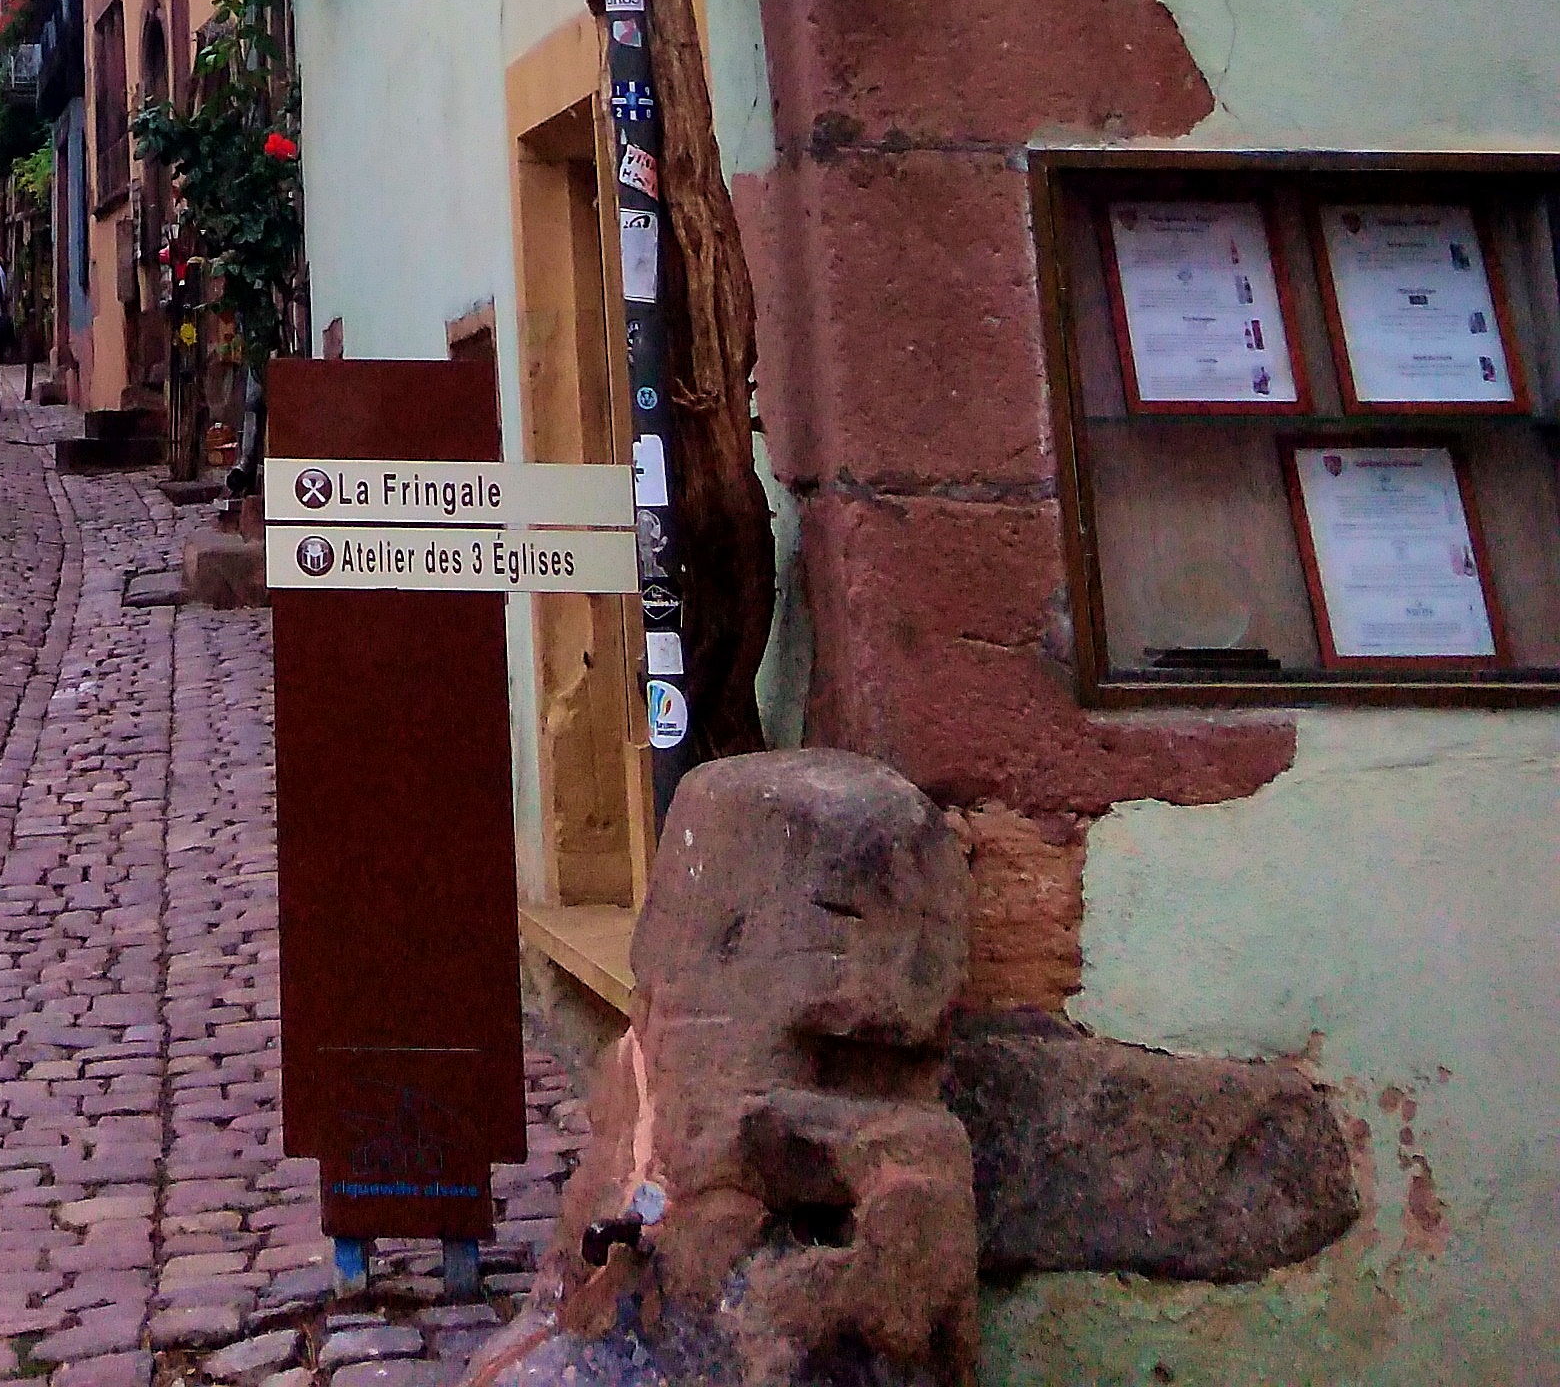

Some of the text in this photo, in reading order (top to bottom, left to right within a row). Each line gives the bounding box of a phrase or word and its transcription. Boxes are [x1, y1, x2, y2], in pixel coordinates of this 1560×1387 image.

[338, 473, 502, 515] La Fringale
[341, 532, 575, 585] Atelier des 3 Églises
